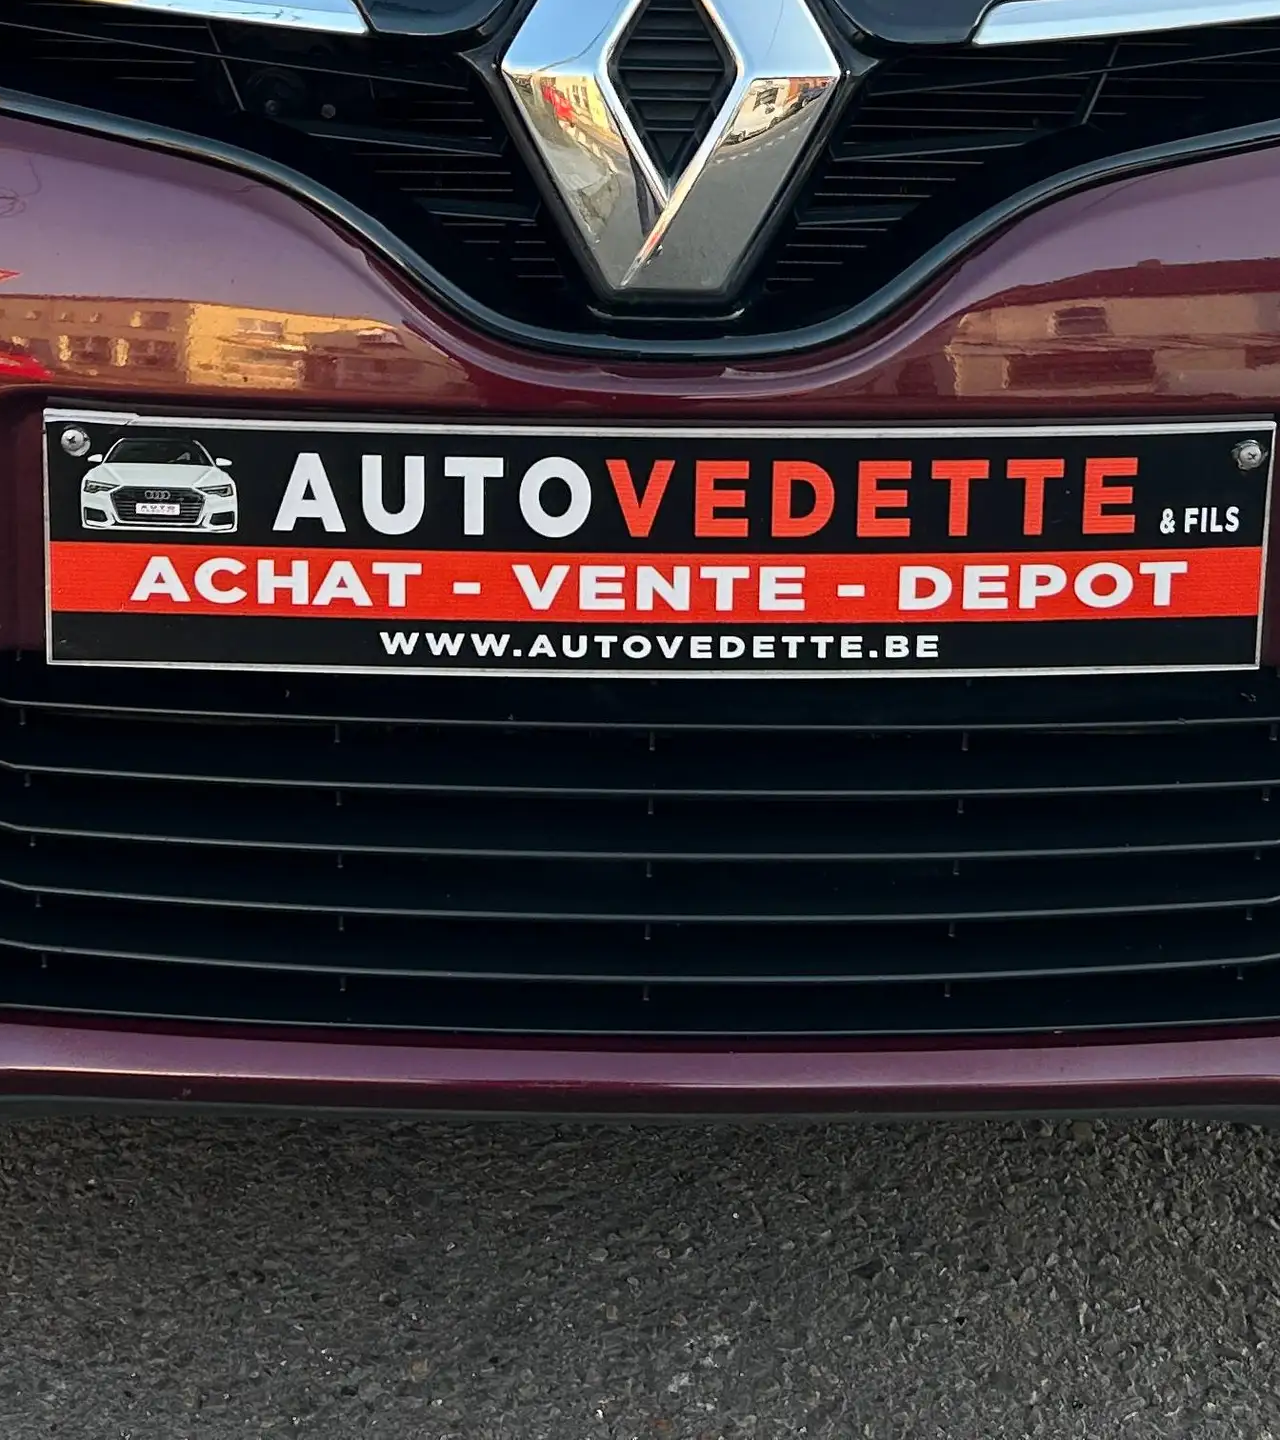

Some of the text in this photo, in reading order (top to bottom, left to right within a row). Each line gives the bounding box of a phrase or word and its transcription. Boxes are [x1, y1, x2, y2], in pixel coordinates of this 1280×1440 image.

[272, 452, 1241, 539] AUTOVEDETTE & FILS
[130, 556, 1190, 613] ACHAT - VENTE - DEPOT
[379, 631, 941, 661] WWW.AUTOVEDETTE.BE
